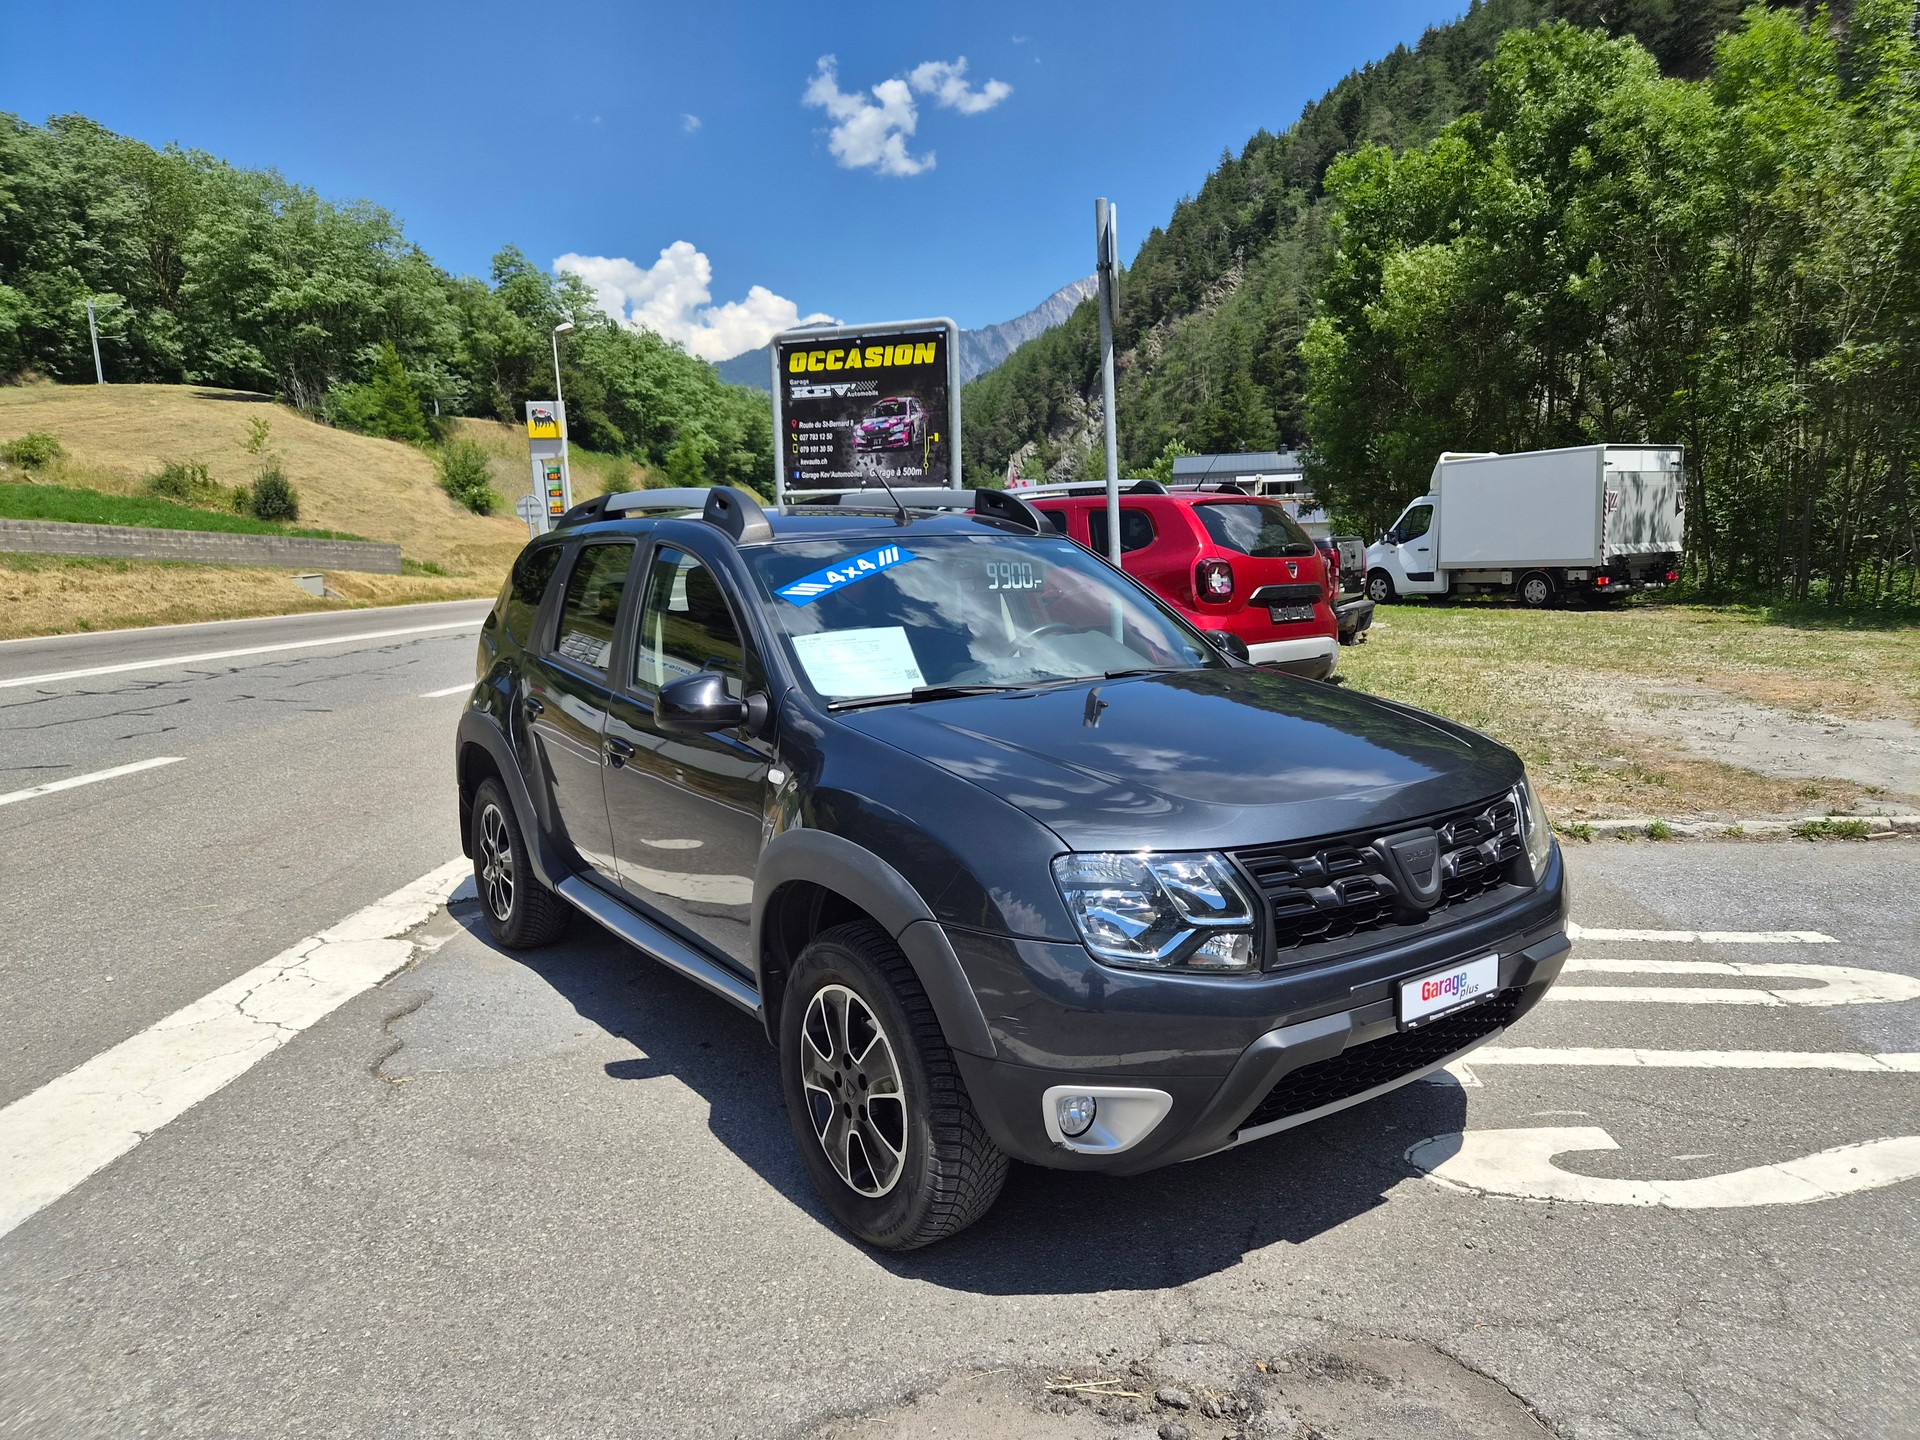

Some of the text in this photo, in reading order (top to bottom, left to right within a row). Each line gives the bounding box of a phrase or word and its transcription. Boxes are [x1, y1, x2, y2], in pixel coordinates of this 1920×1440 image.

[788, 342, 936, 373] OCCASION
[798, 421, 814, 429] Route
[814, 420, 822, 429] du
[822, 419, 850, 428] St-Bernard
[799, 433, 809, 442] 027
[819, 432, 826, 441] 12
[826, 432, 833, 440] 50
[799, 445, 834, 453] 079 101 30 50
[800, 457, 828, 466] kevauto.ch
[801, 471, 820, 480] Garage
[869, 466, 923, 479] Grage à 500m
[826, 558, 876, 584] 4x4
[1405, 848, 1436, 863] DACIA
[1421, 971, 1479, 1002] Garage plus
